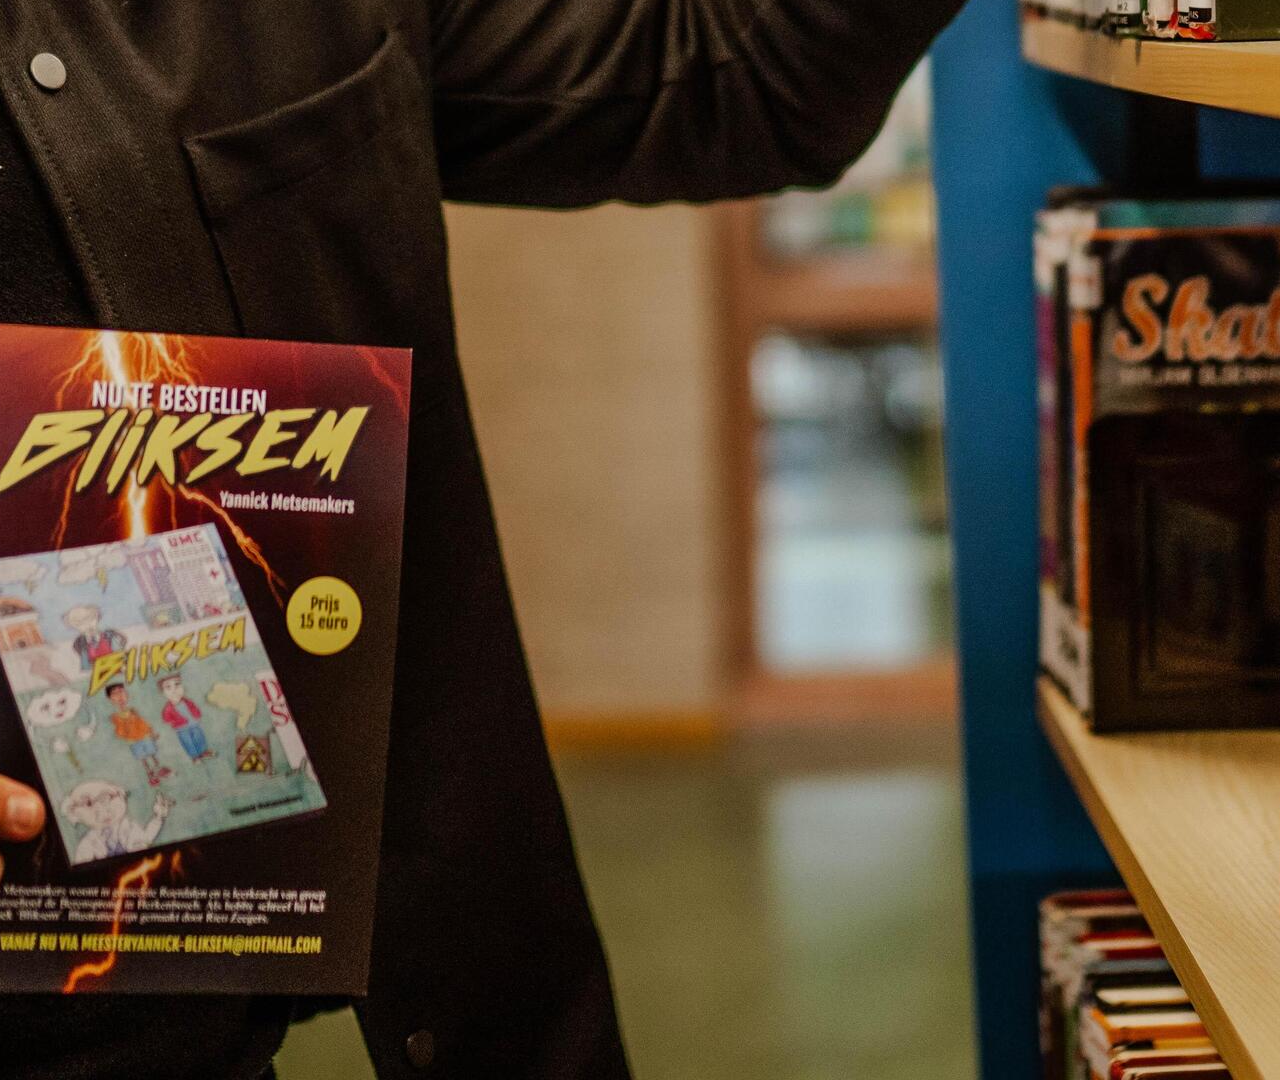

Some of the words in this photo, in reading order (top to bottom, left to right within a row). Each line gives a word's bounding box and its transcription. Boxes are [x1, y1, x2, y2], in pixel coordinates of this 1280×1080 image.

[92, 380, 123, 408] NU
[129, 382, 154, 402] TE
[159, 383, 268, 415] BESTELLEN
[219, 490, 269, 510] Yannick
[270, 492, 355, 515] Metsemakers
[310, 594, 340, 616] Prijs
[299, 614, 315, 630] 15
[317, 615, 349, 631] euro
[0, 931, 38, 952] VANAF
[39, 932, 58, 952] NU
[58, 932, 79, 952] VIA
